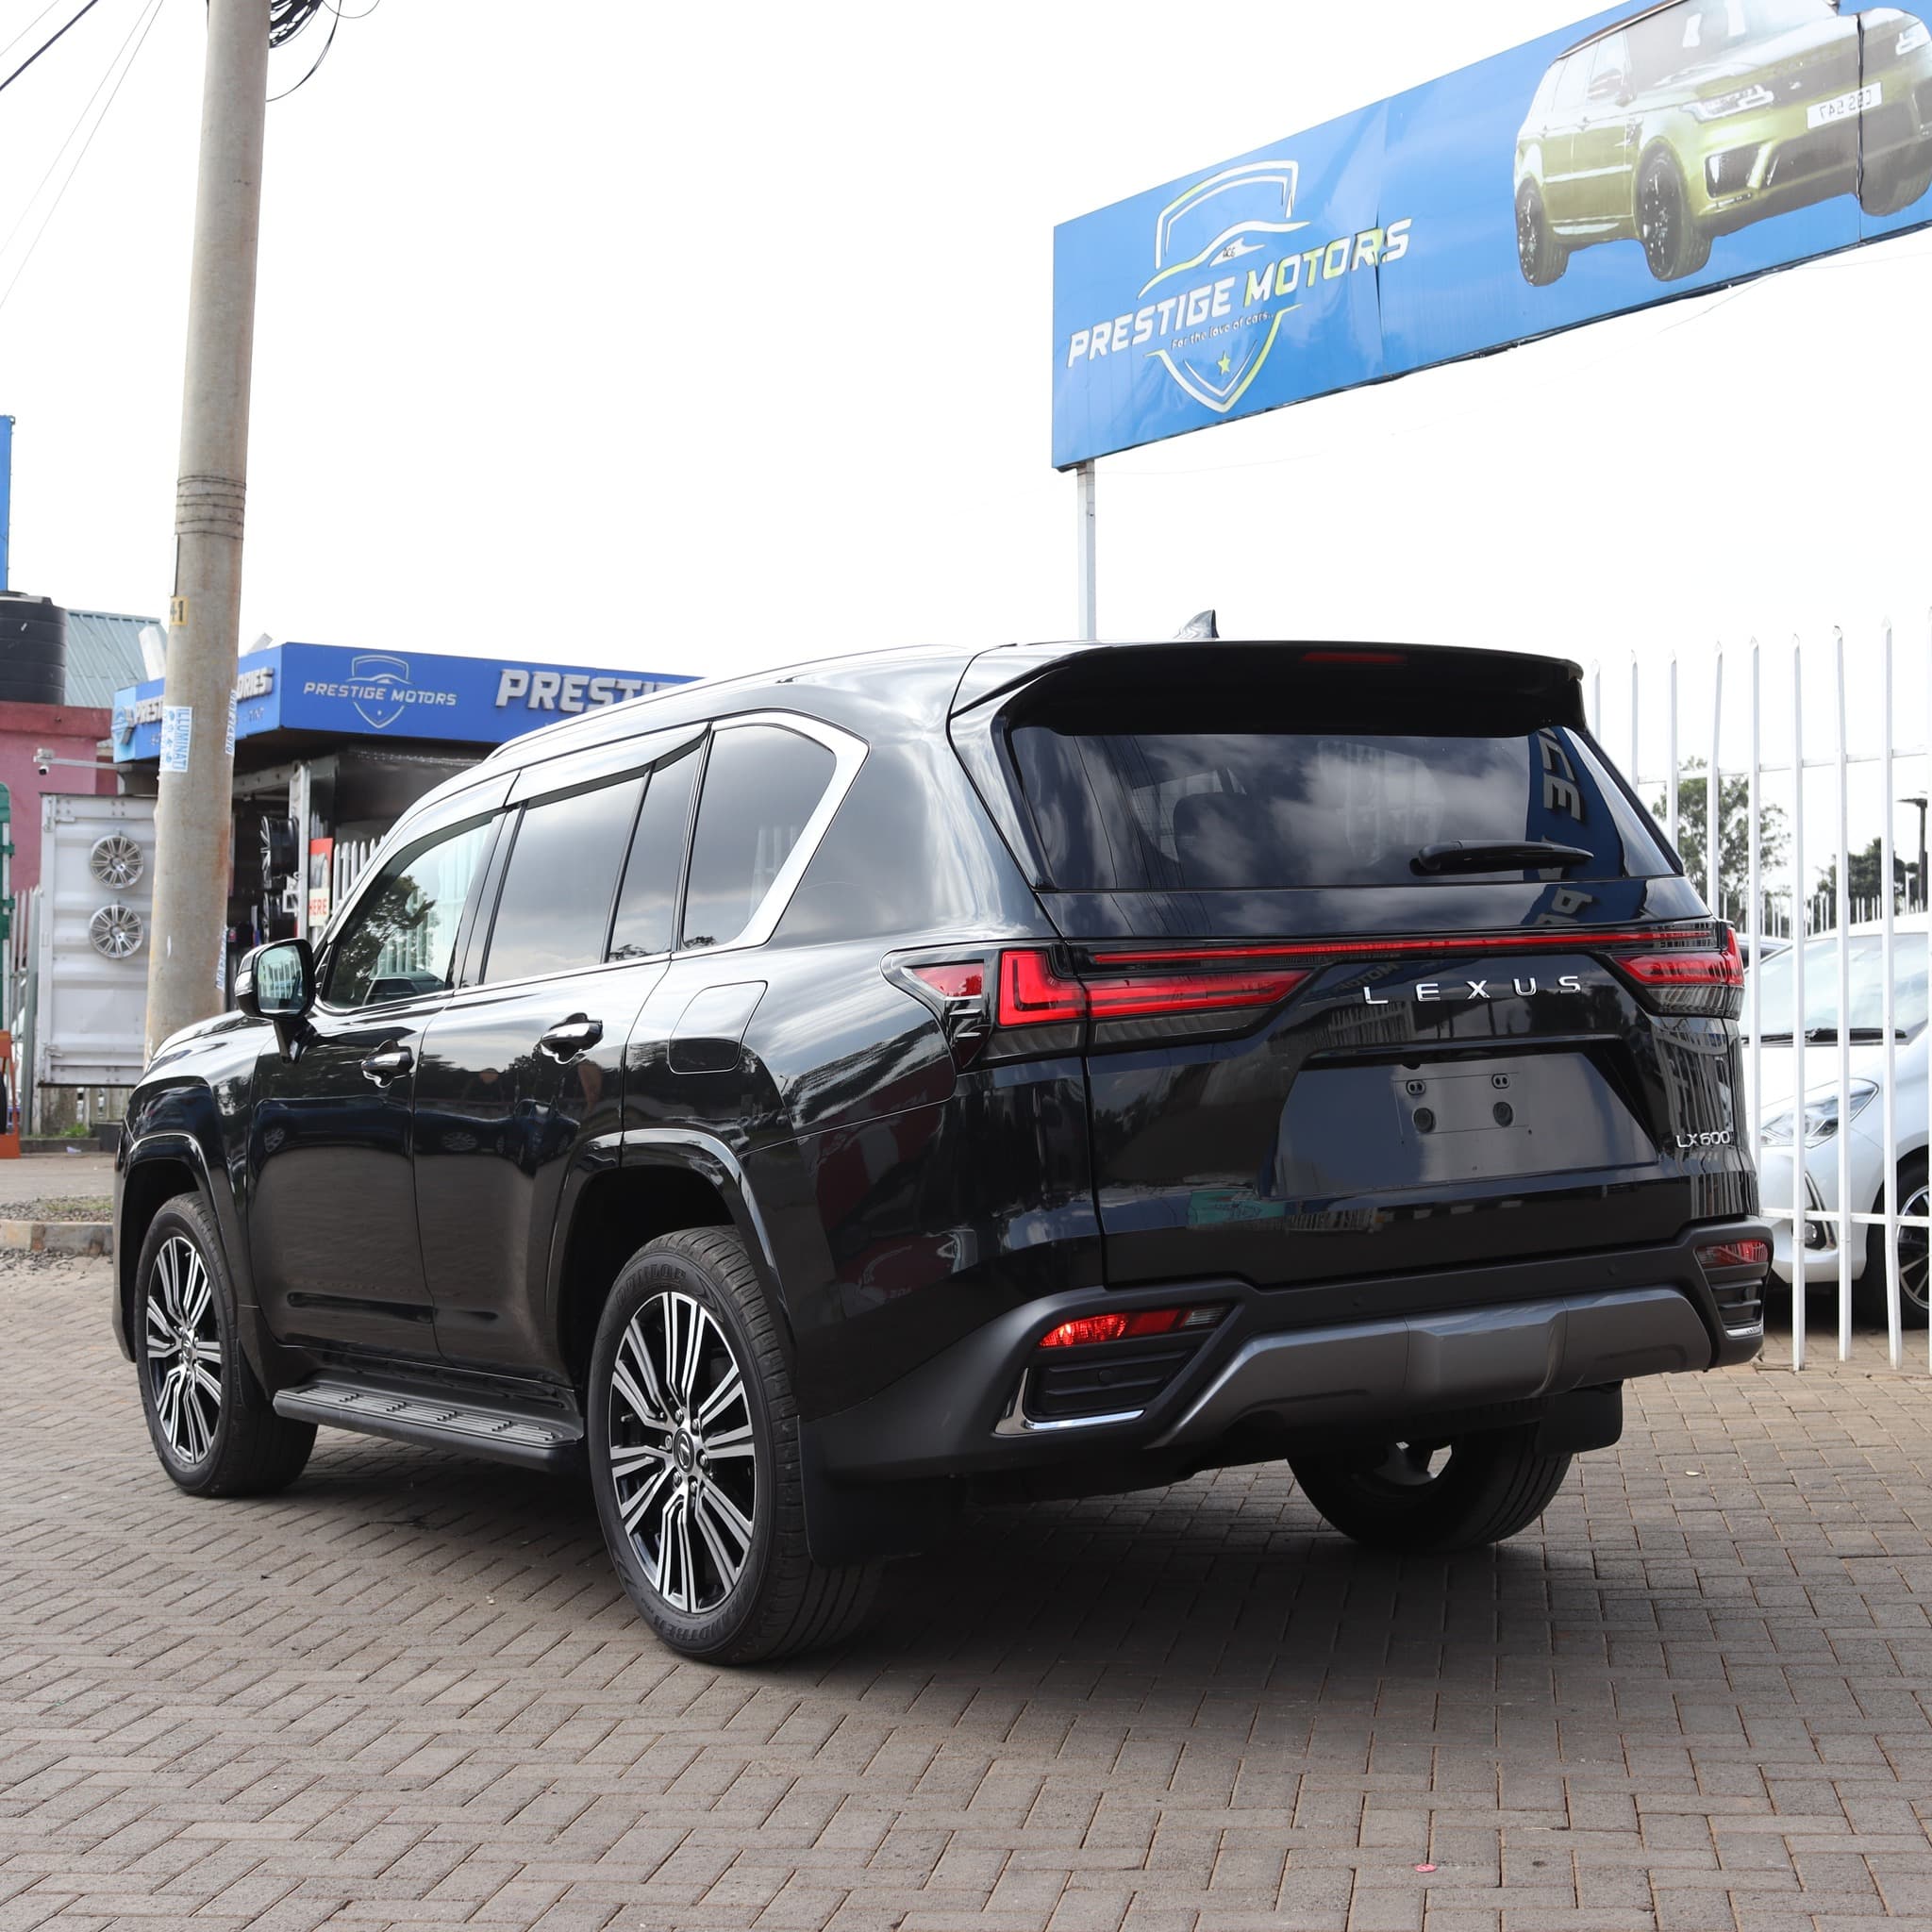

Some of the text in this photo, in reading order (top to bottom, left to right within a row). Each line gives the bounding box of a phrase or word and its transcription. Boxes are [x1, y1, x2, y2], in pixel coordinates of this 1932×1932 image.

[1066, 217, 1412, 369] PRESTIGE MOTORS
[1171, 338, 1188, 350] For
[1190, 330, 1207, 345] the
[1209, 324, 1230, 339] love
[1233, 317, 1244, 330] of
[303, 681, 458, 707] PRESTIGE MOTORS
[173, 708, 191, 771] ILLUMINATI
[1363, 974, 1582, 1006] LEXUS
